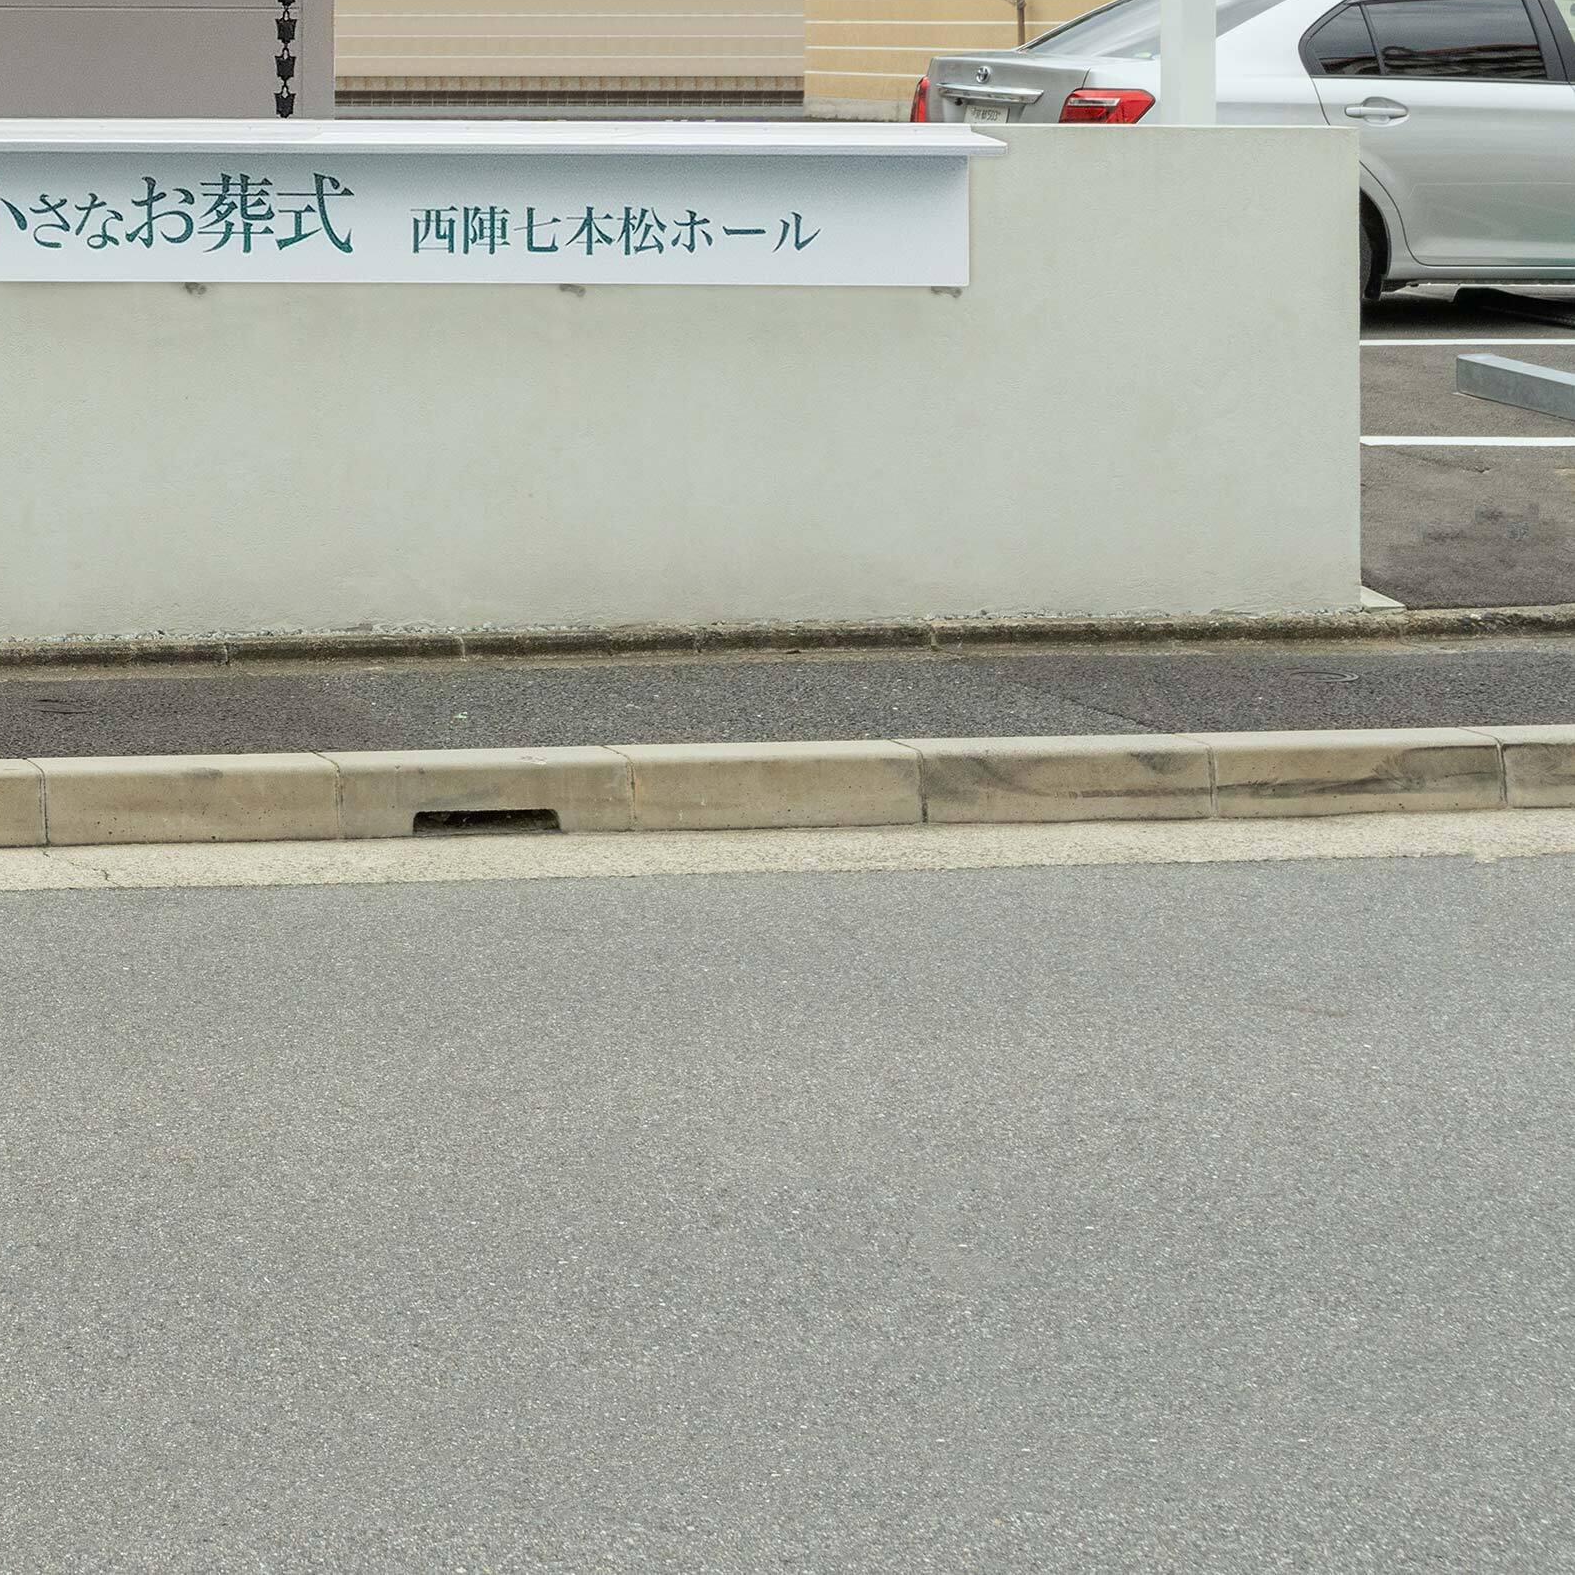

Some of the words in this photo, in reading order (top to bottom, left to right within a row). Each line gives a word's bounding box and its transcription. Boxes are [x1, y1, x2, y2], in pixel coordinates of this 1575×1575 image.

[411, 205, 821, 255] 西陣七本松ホール
